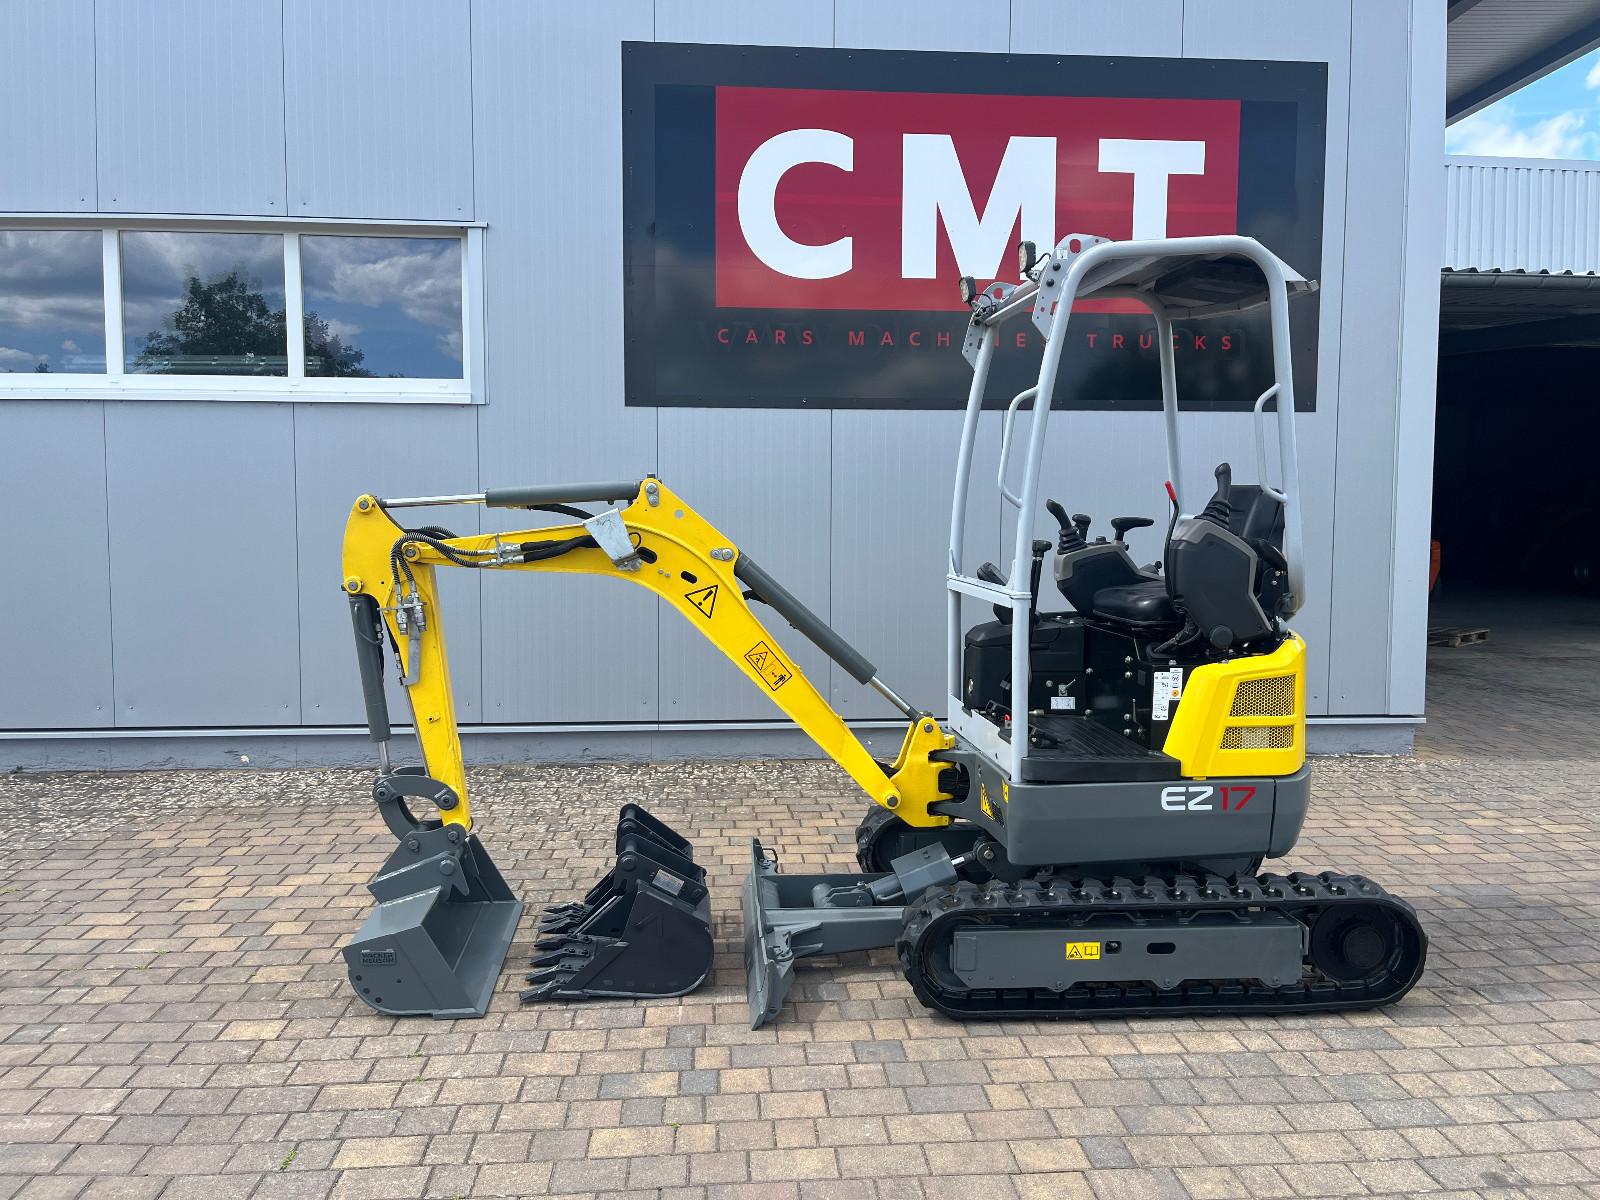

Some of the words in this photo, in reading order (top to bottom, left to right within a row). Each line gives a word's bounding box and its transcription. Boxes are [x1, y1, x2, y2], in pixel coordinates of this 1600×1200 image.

[737, 128, 1206, 280] CMT
[717, 328, 813, 344] CARS
[849, 331, 1049, 348] MACHE
